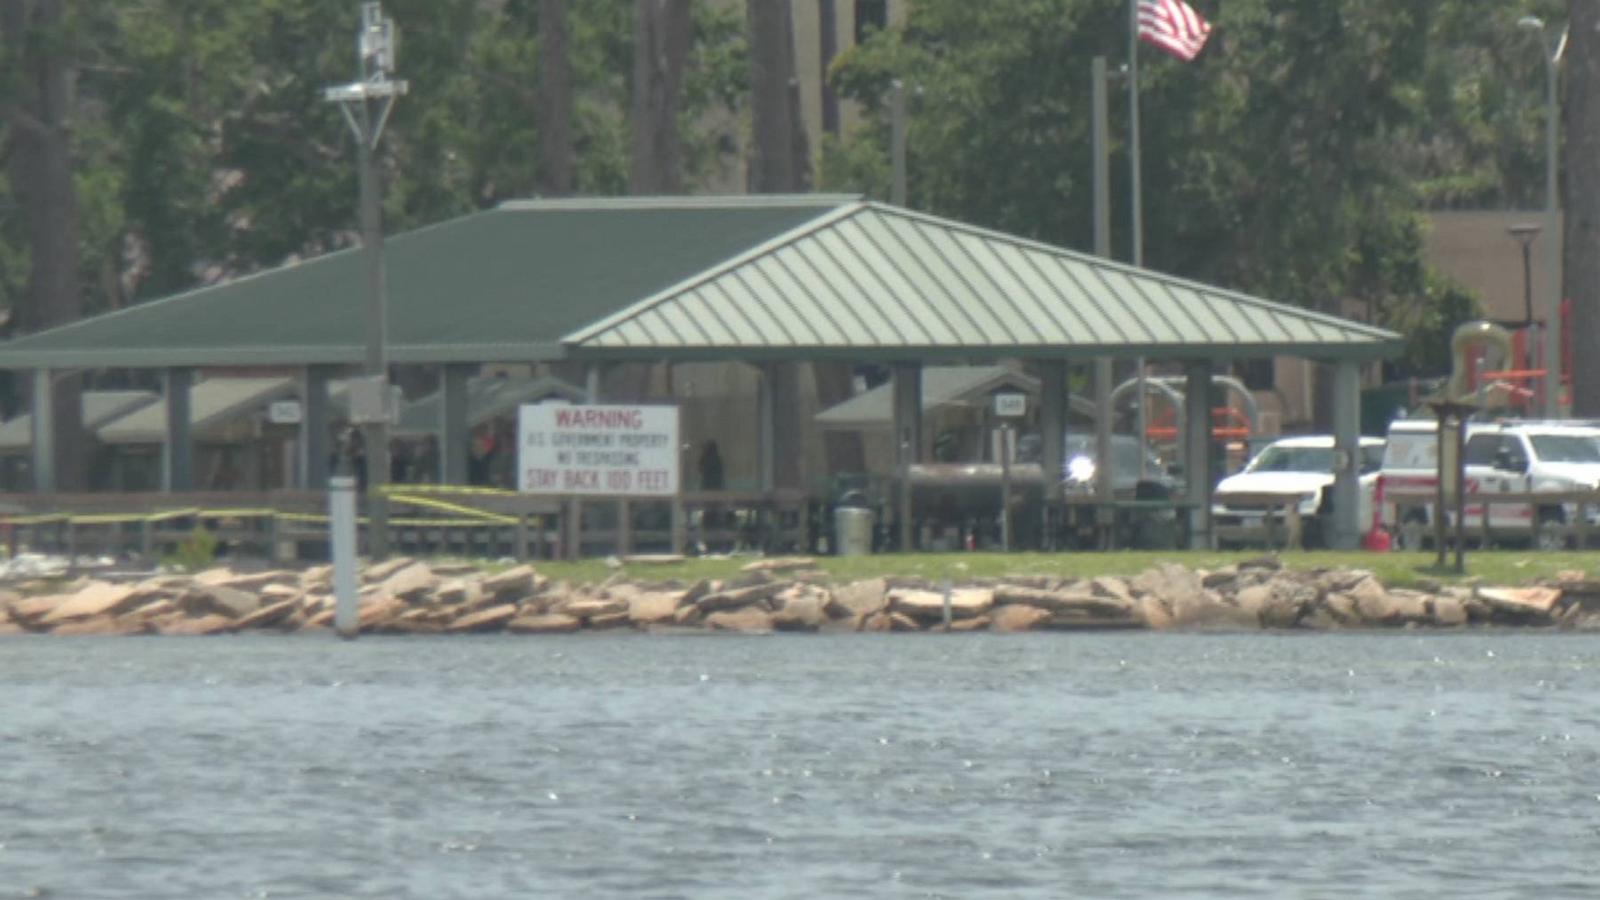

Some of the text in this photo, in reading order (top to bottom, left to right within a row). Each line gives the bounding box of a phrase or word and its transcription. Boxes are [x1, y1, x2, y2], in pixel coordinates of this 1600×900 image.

[555, 409, 643, 429] WARNING
[550, 432, 614, 447] GOVERNMENT
[618, 433, 669, 447] PROPERTY
[526, 469, 669, 490] STAY BACK 100 FEET
